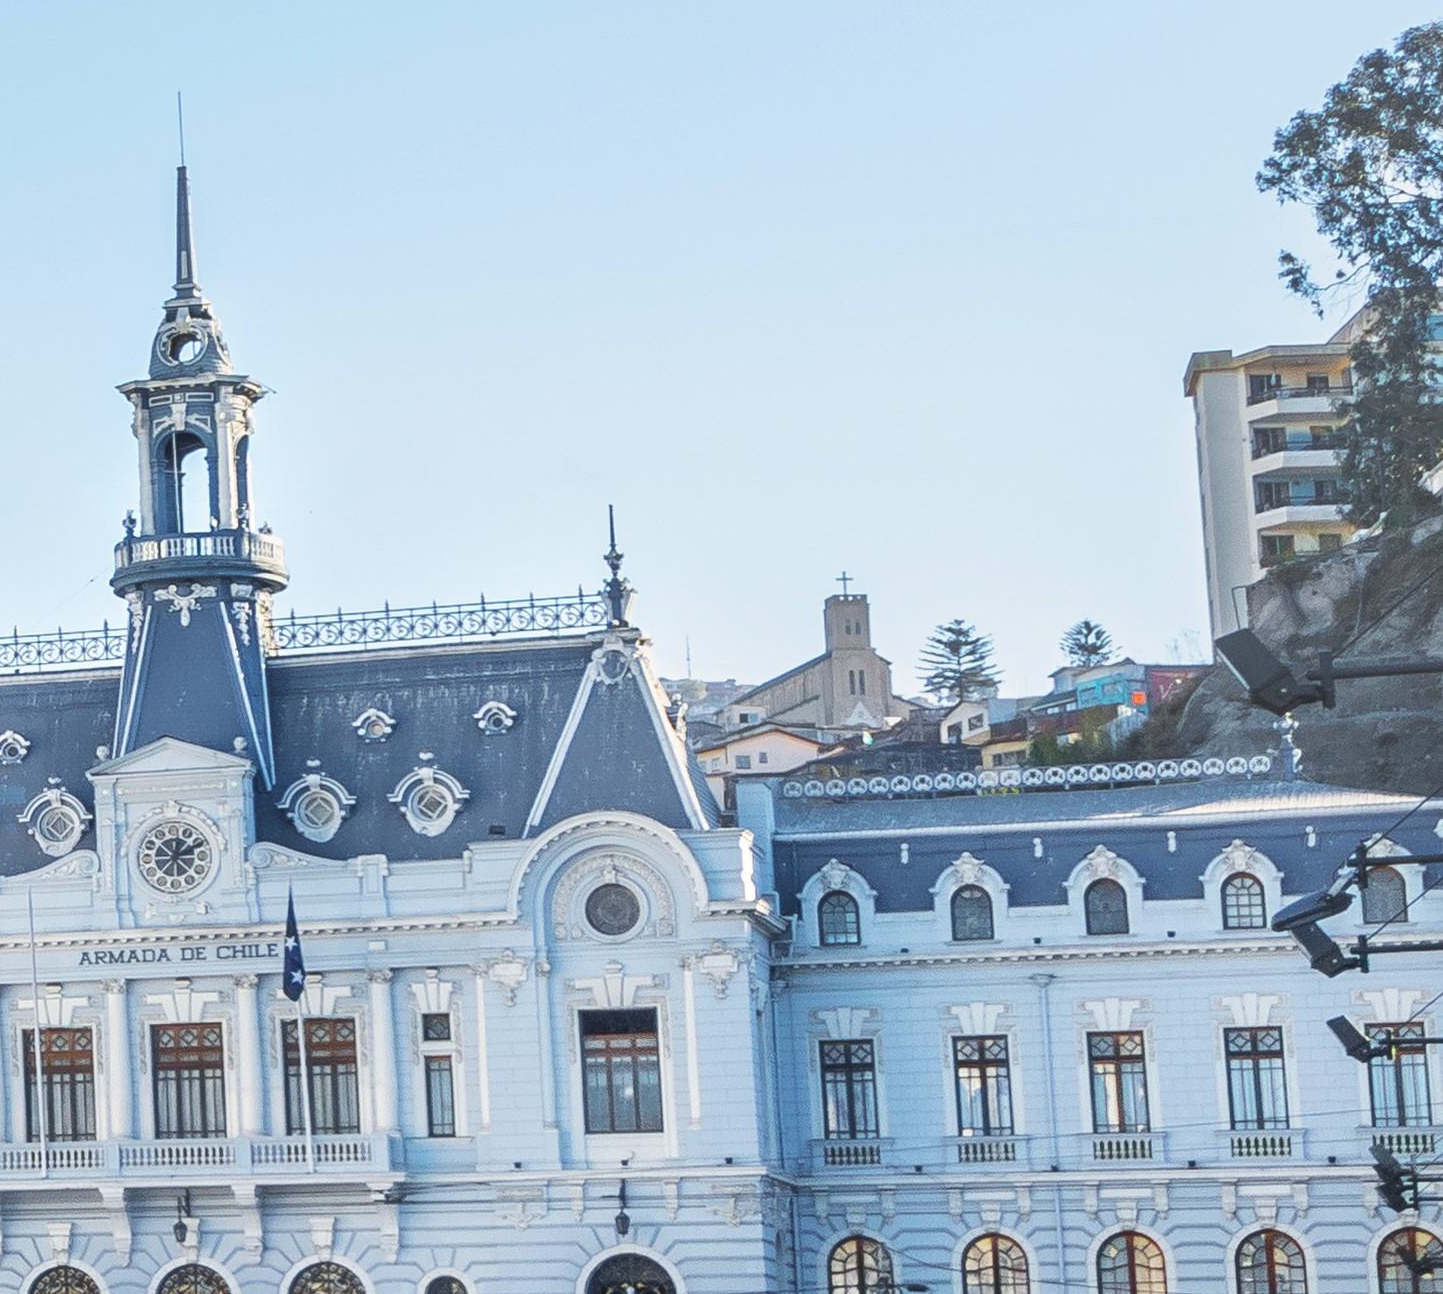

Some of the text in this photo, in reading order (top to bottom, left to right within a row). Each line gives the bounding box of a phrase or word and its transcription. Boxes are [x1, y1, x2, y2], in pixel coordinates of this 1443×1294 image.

[79, 943, 279, 966] ARMADA DE CHILE
